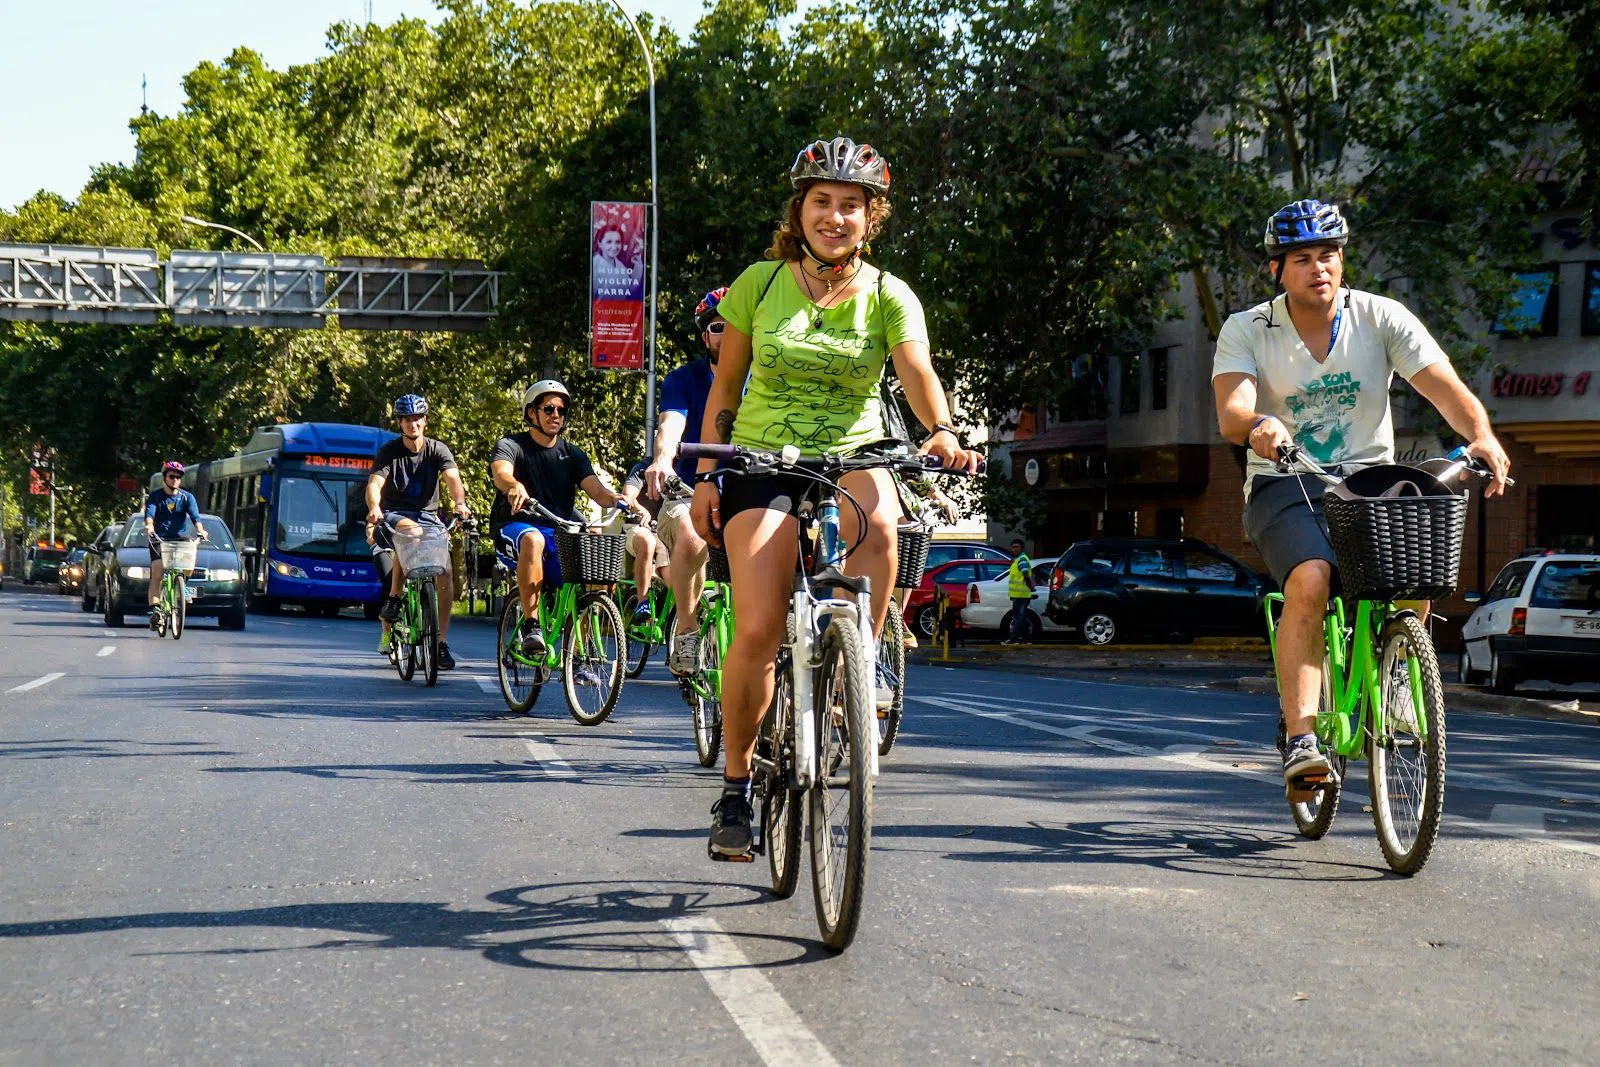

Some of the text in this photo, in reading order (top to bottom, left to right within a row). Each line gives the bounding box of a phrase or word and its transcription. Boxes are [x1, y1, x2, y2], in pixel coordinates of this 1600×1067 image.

[598, 267, 633, 275] MUSEO
[598, 278, 639, 286] VIOLETA
[597, 288, 631, 296] PARRA
[287, 524, 311, 534] 210v
